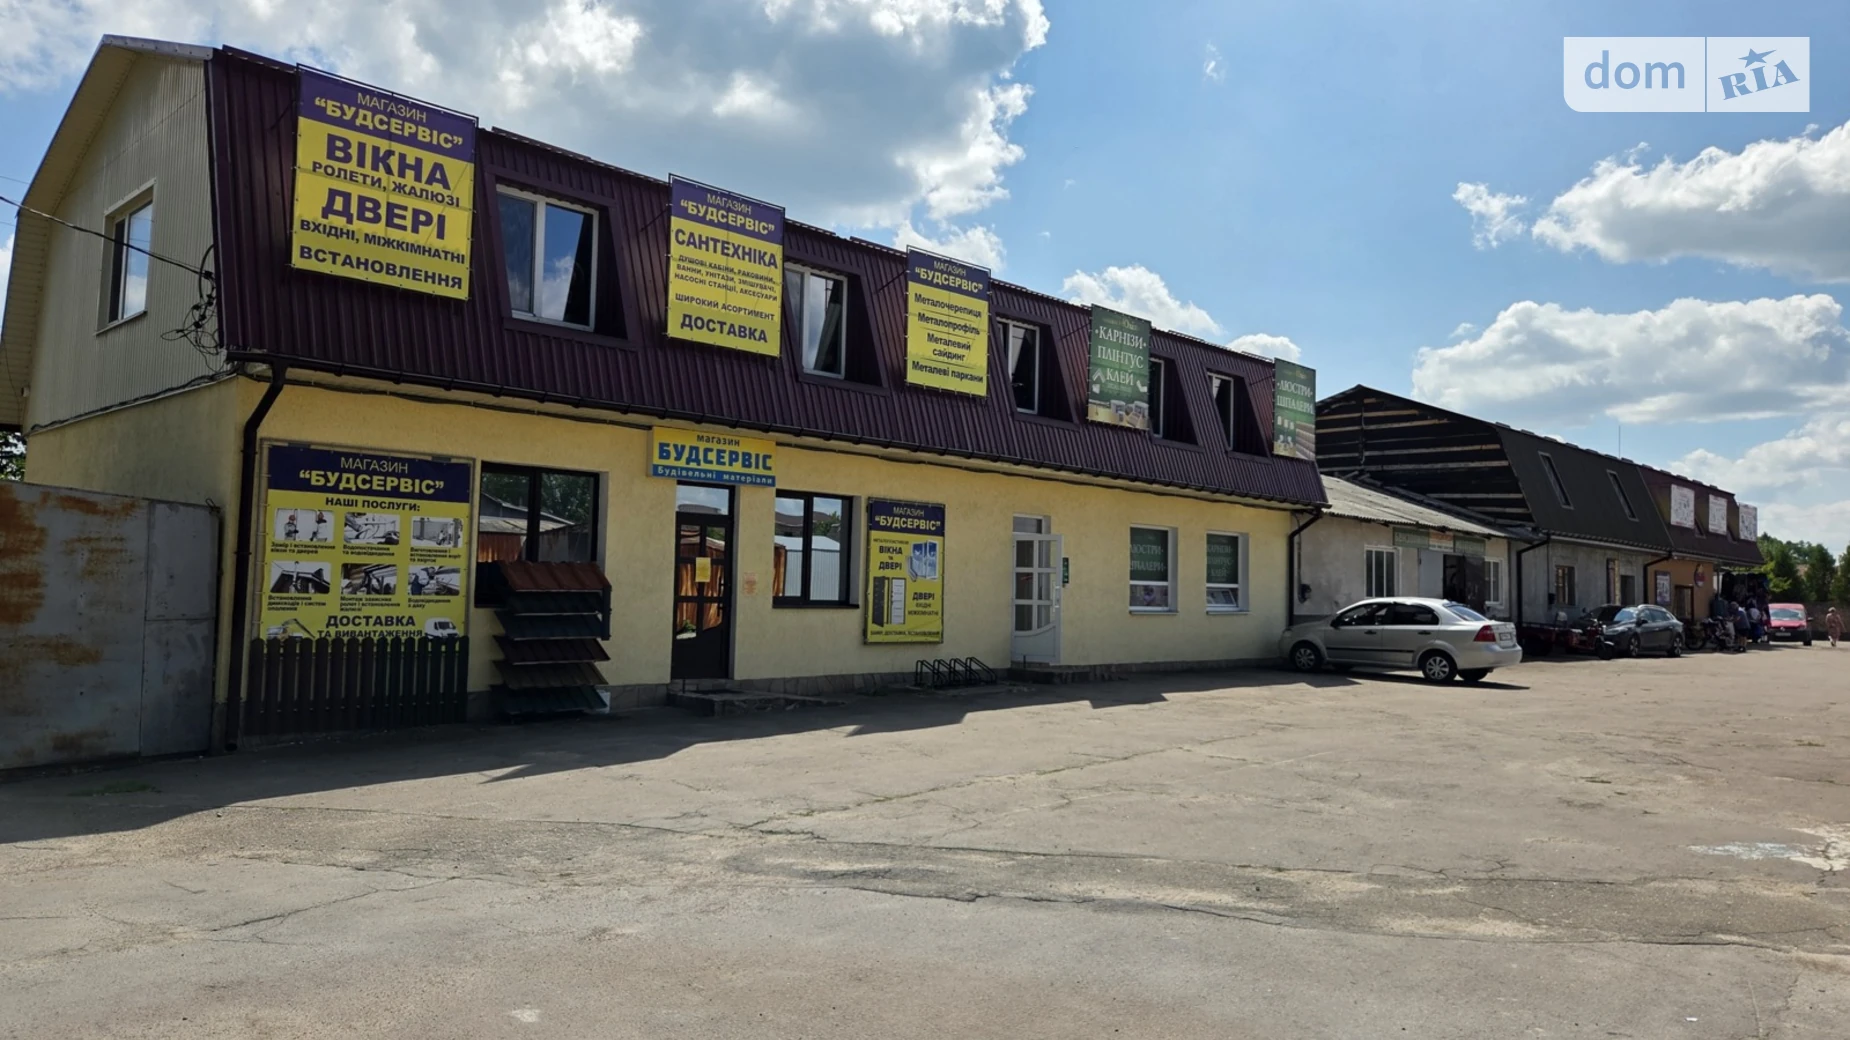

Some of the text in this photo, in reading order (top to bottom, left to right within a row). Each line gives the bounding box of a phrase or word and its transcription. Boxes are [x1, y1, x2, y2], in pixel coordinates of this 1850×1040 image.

[357, 92, 427, 123] МАГАЗИН
[326, 133, 451, 191] ВІКНА
[312, 161, 460, 207] РОЛЕТИ, ЖАЛЮЗІ
[321, 188, 446, 240] ДВЕРІ
[707, 193, 752, 215] МАГАЗИН
[300, 219, 466, 264] ВХІДНІ, МІЖКІМНАТНІ
[674, 228, 779, 270] САНТЕХНІКА
[299, 245, 462, 289] ВСТАНОВЛЕННЯ
[679, 255, 707, 267] ДУШОВІ
[708, 262, 737, 274] КАБІНИ,
[933, 261, 967, 277] МАГАЗИН
[674, 272, 778, 302] НАСОСНІ СТАНЦІЇ, АКСЕСУАРИ
[677, 264, 776, 293] ВАННИ, УНІТАЗИ, ЗМІШУВАЧІ,
[675, 293, 775, 321] ШИРОКИЙ АСОРТИМЕНТ
[914, 292, 982, 318] Металочерепиця
[680, 313, 768, 343] ДОСТАВКА
[917, 312, 980, 336] Металопрофіль
[926, 332, 971, 351] Металевий
[1098, 326, 1143, 349] КАРНІЗИ
[932, 347, 965, 362] сайдинг
[1097, 345, 1144, 369] ПЛІНТУС
[911, 360, 984, 383] Металеві паркани
[1106, 367, 1134, 386] КЛЕЙ
[1277, 395, 1314, 414] ШПАЛЕРИ
[697, 434, 740, 446] магазин
[340, 457, 408, 474] МАГАЗИН
[658, 442, 773, 471] БУДСЕРВІС
[657, 466, 773, 485] Будівельні матеріали
[325, 497, 421, 512] НАШІ ПОСЛУГИ:
[893, 506, 925, 517] МАГАЗИН
[879, 545, 903, 554] ВІКНА
[878, 561, 903, 570] ДВЕРІ
[912, 592, 935, 601] ДВЕРІ
[325, 615, 416, 629] ДОСТАВКА
[317, 629, 423, 638] ТА ВИВАНТАЖЕННЯ
